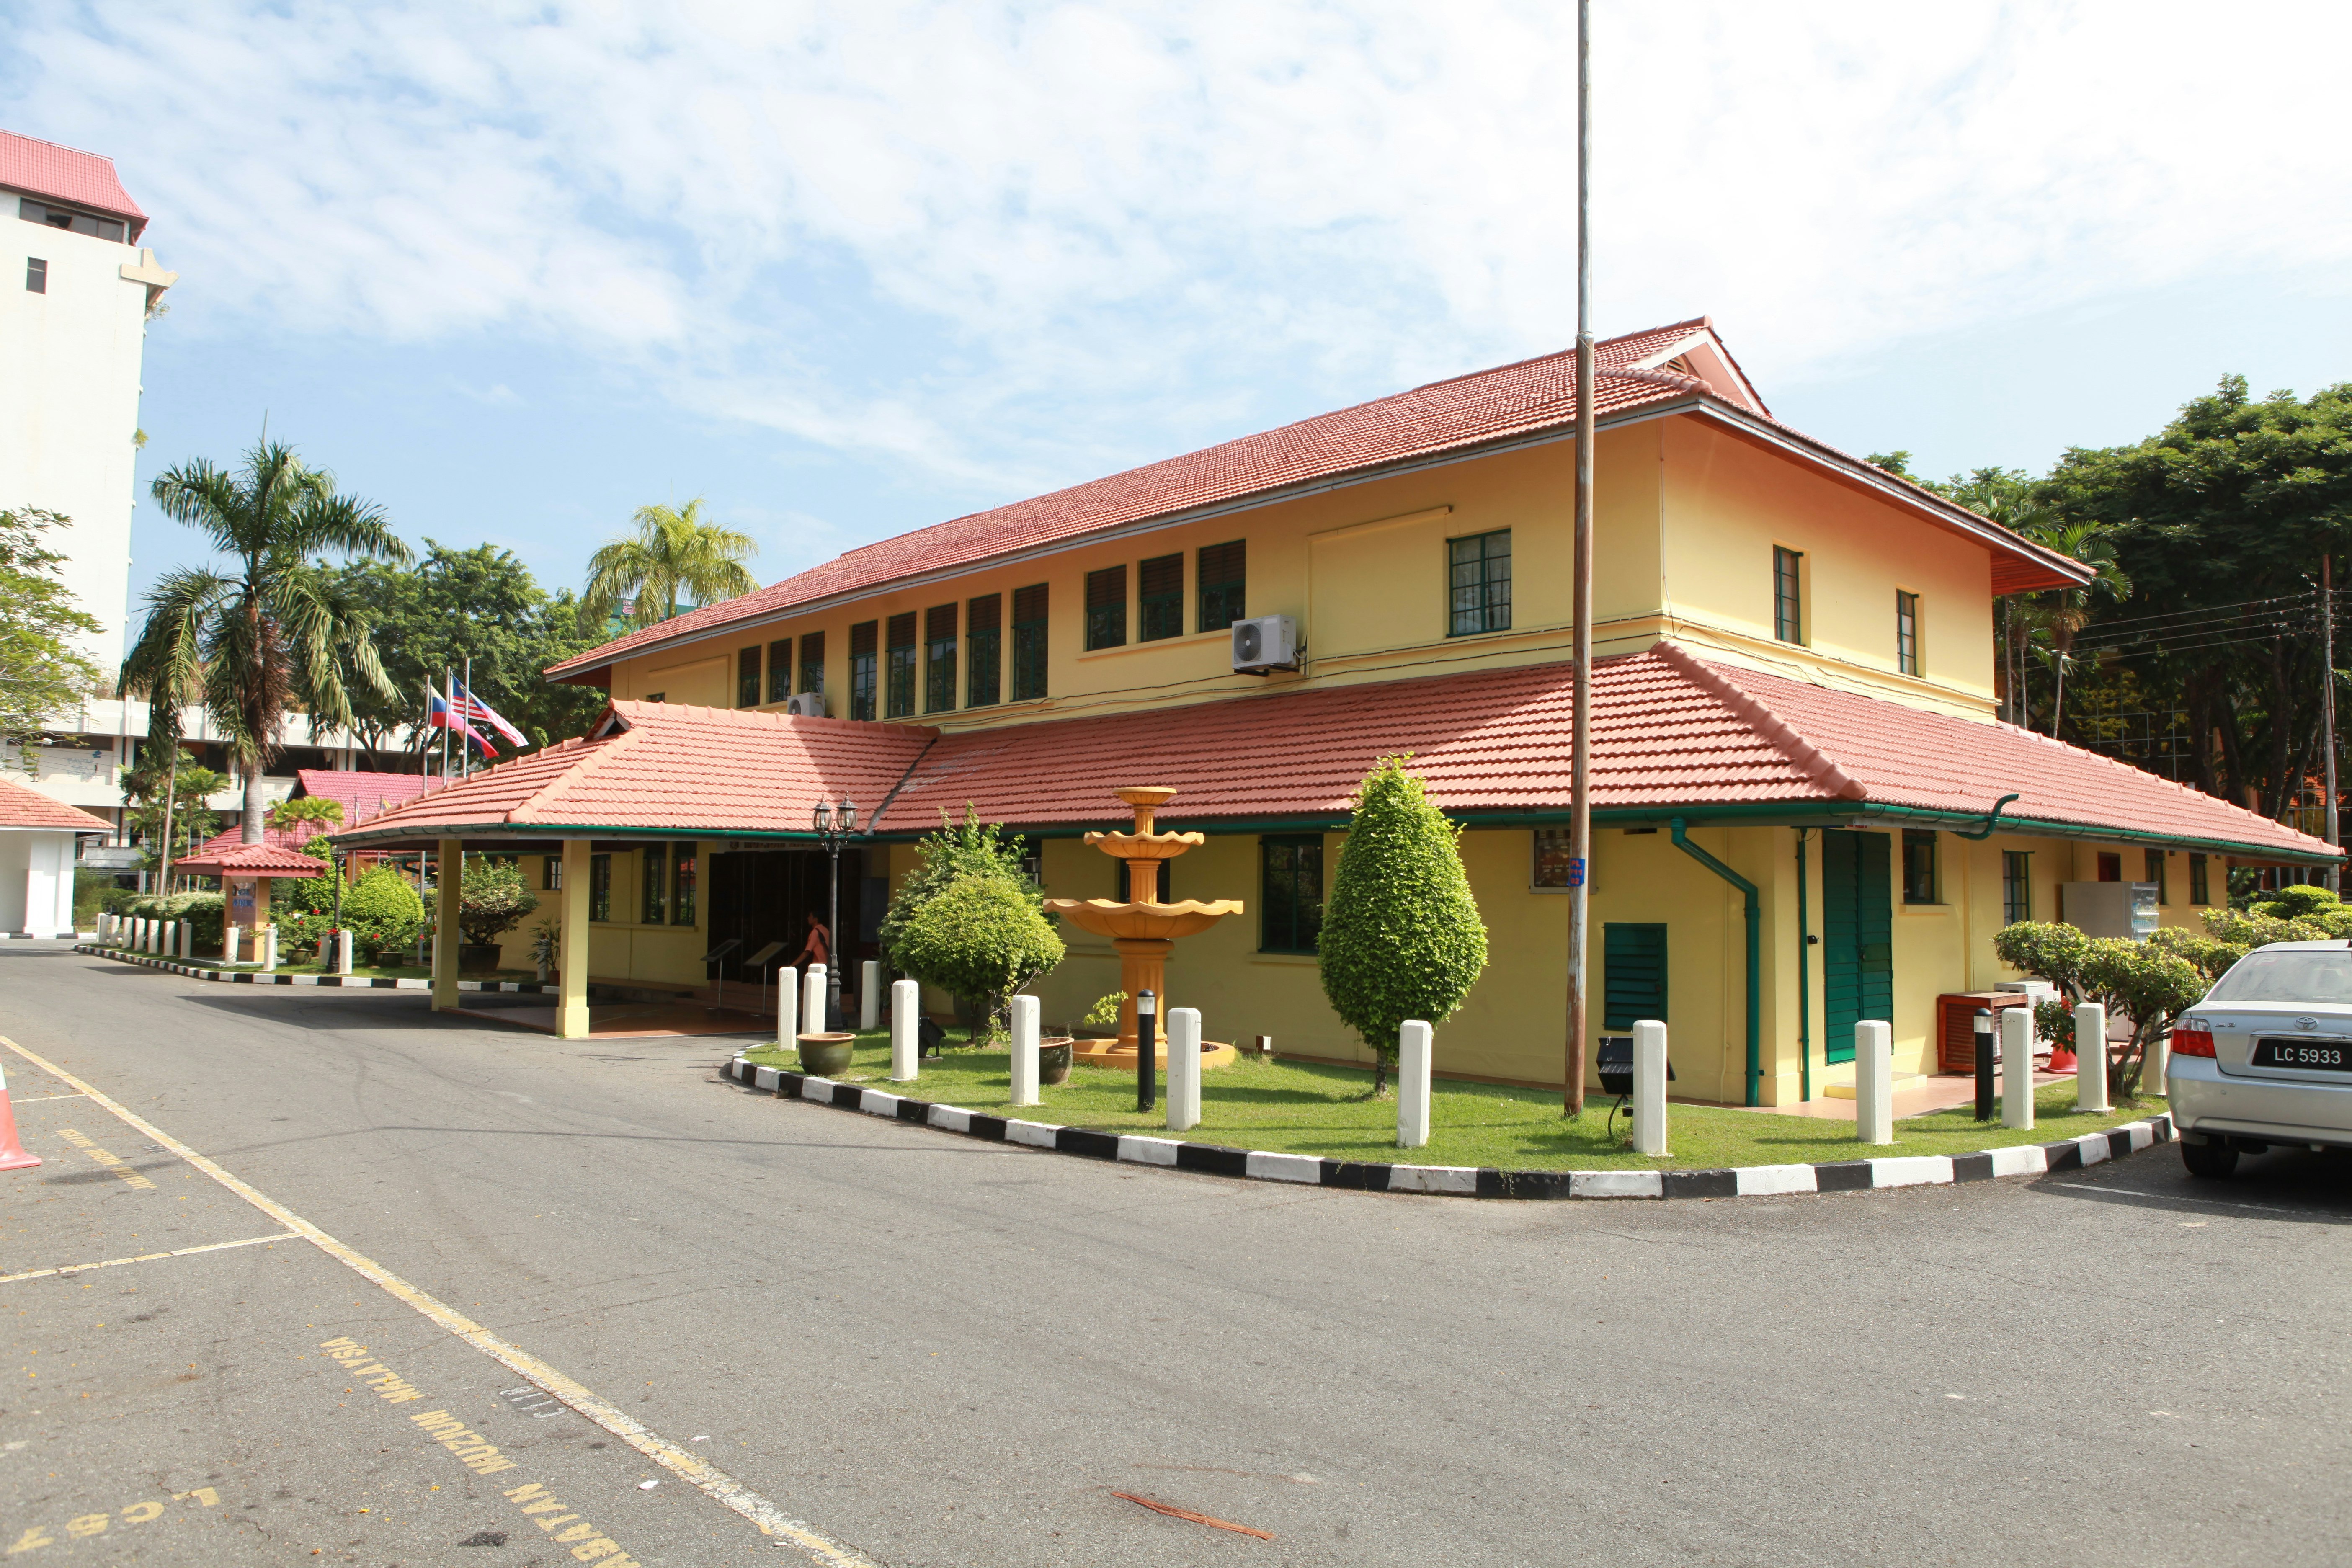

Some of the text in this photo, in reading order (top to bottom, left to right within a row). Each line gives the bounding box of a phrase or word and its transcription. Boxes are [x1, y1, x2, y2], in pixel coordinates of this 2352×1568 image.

[2275, 1047, 2342, 1064] LC 5933
[320, 1336, 425, 1403] MALAYSIA
[410, 1409, 518, 1475] MUZIUM
